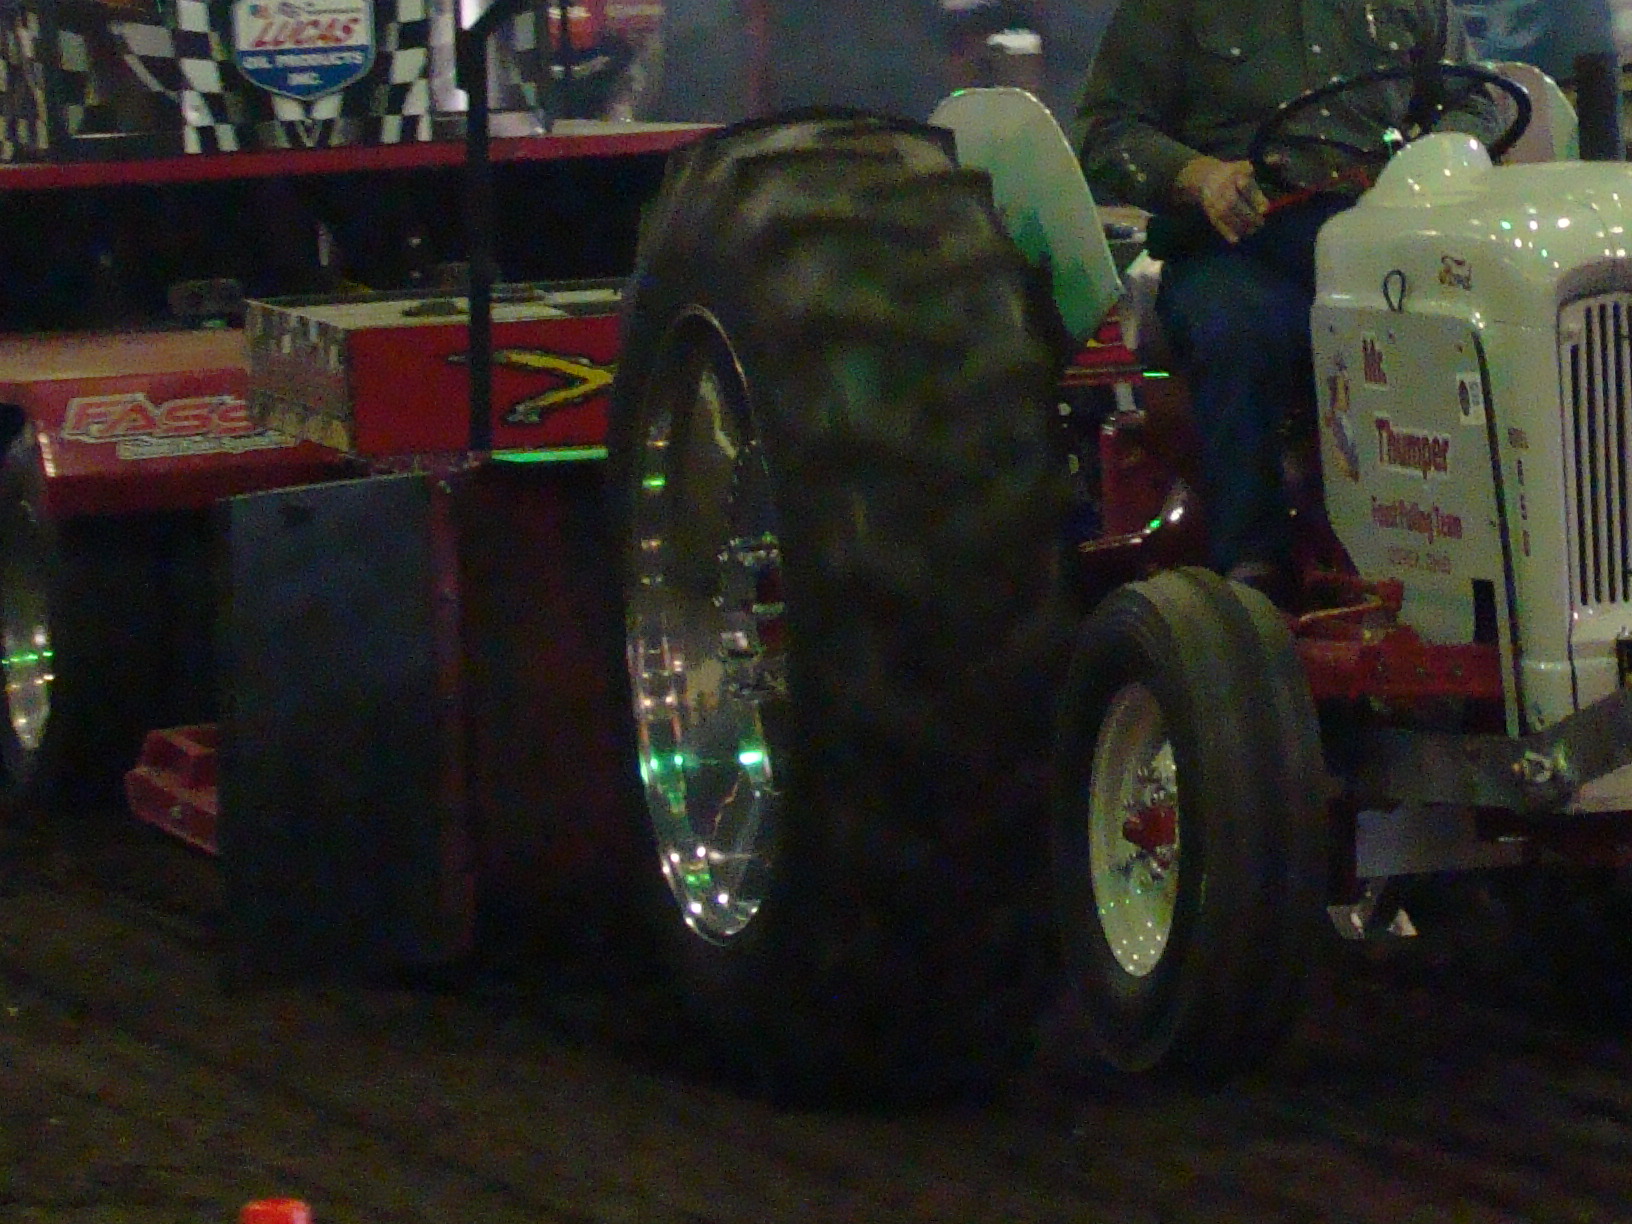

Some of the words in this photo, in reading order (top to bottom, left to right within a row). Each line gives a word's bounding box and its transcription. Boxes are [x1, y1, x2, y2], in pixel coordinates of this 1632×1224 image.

[252, 17, 361, 48] LUCAS
[242, 55, 273, 70] OIL
[275, 50, 364, 68] PRODUCTS
[1375, 417, 1451, 482] Thumper
